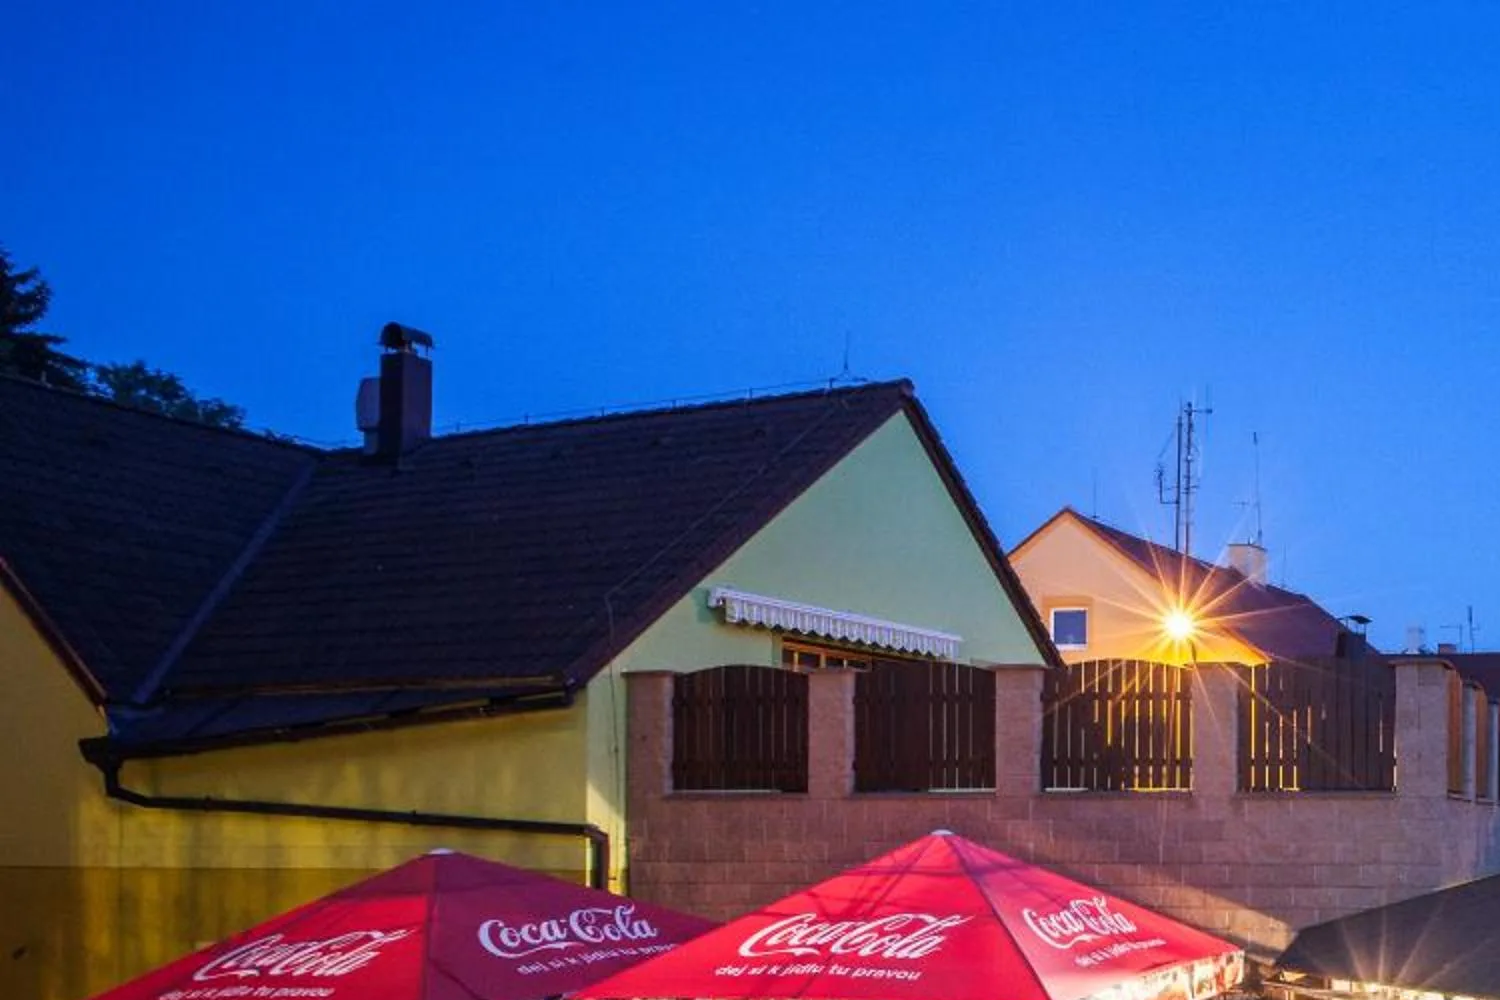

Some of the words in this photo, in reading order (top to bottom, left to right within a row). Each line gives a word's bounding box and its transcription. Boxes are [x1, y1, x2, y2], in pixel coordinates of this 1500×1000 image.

[477, 903, 659, 959] Coca-Cola
[738, 912, 976, 960] Coca-Cola
[1021, 896, 1137, 950] Coca-Cola
[851, 966, 922, 981] pravou
